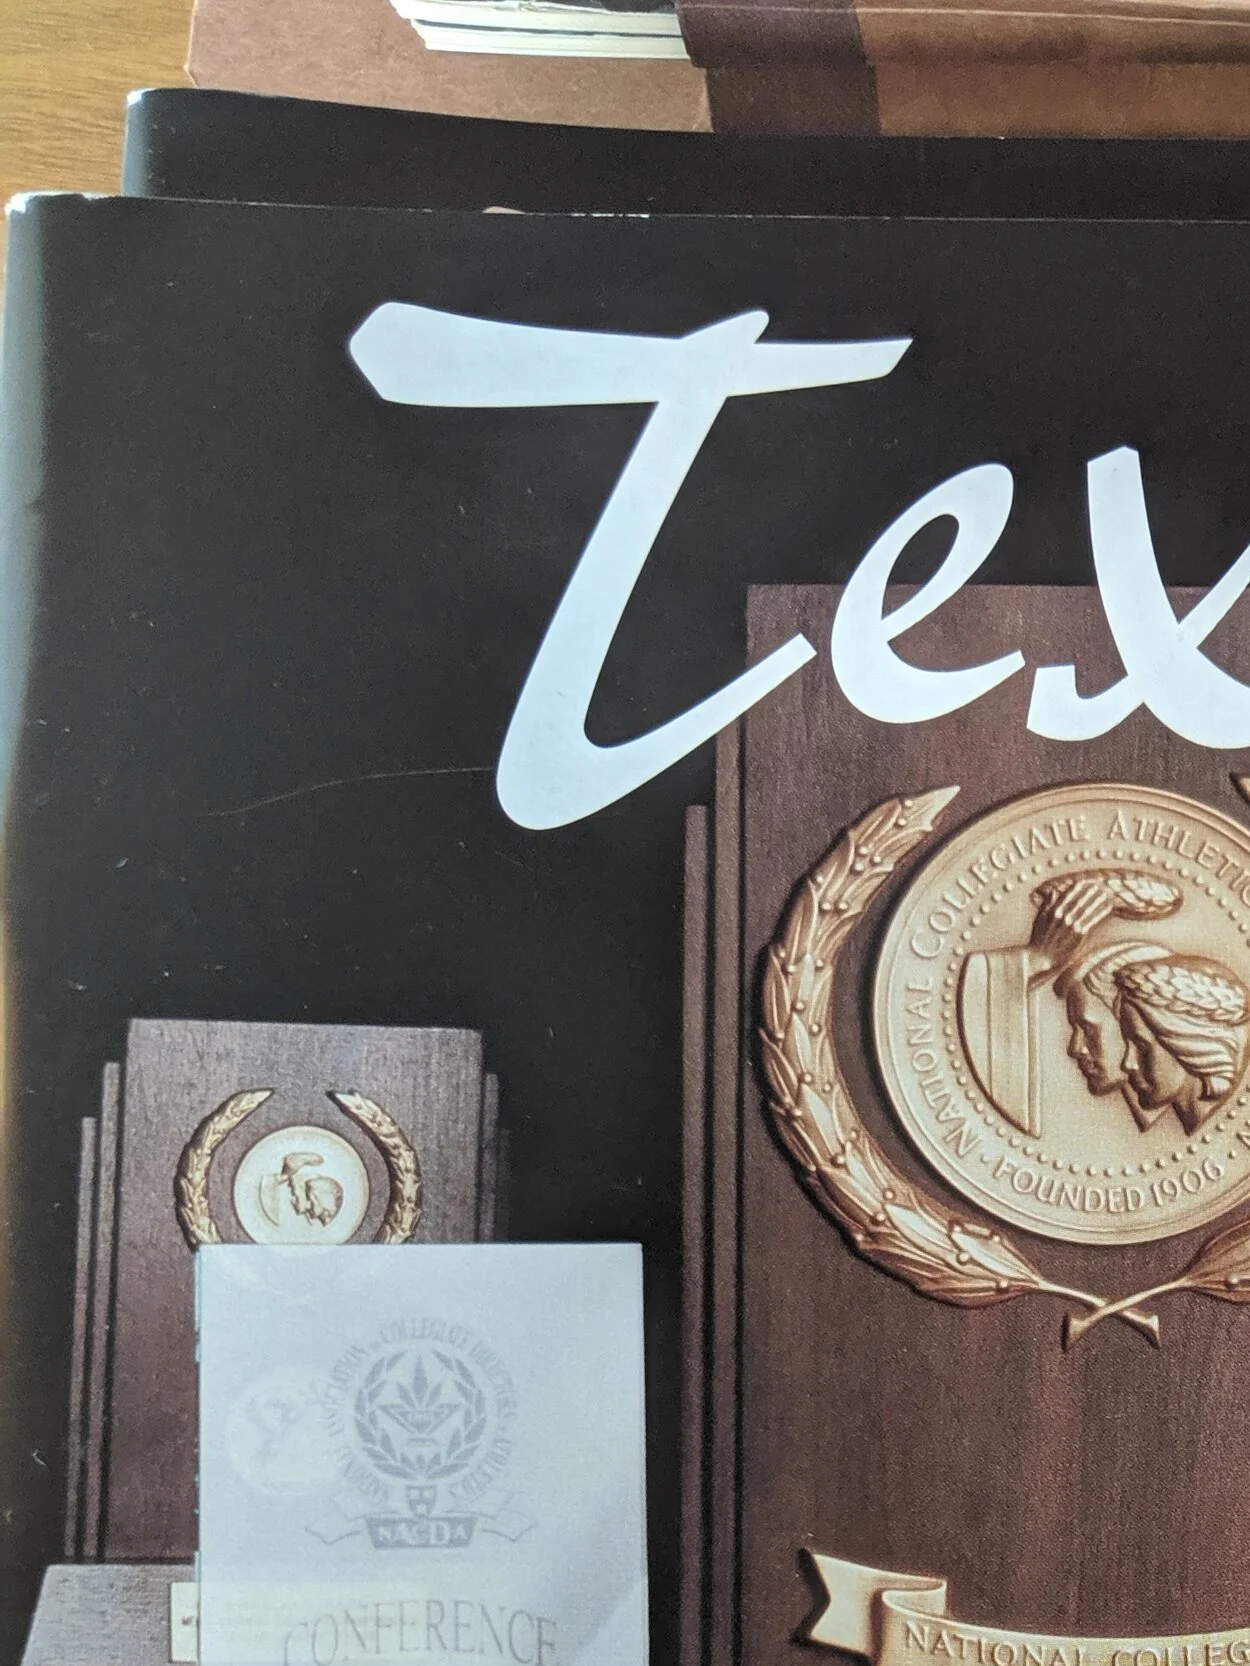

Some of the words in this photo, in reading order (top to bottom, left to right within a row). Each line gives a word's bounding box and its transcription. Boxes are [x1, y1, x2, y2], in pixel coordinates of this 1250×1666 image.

[911, 816, 1088, 958] COLLEGIATE
[906, 979, 982, 1159] NATIONAL
[993, 1157, 1145, 1214] FOUNDED
[1150, 1161, 1225, 1207] 1906
